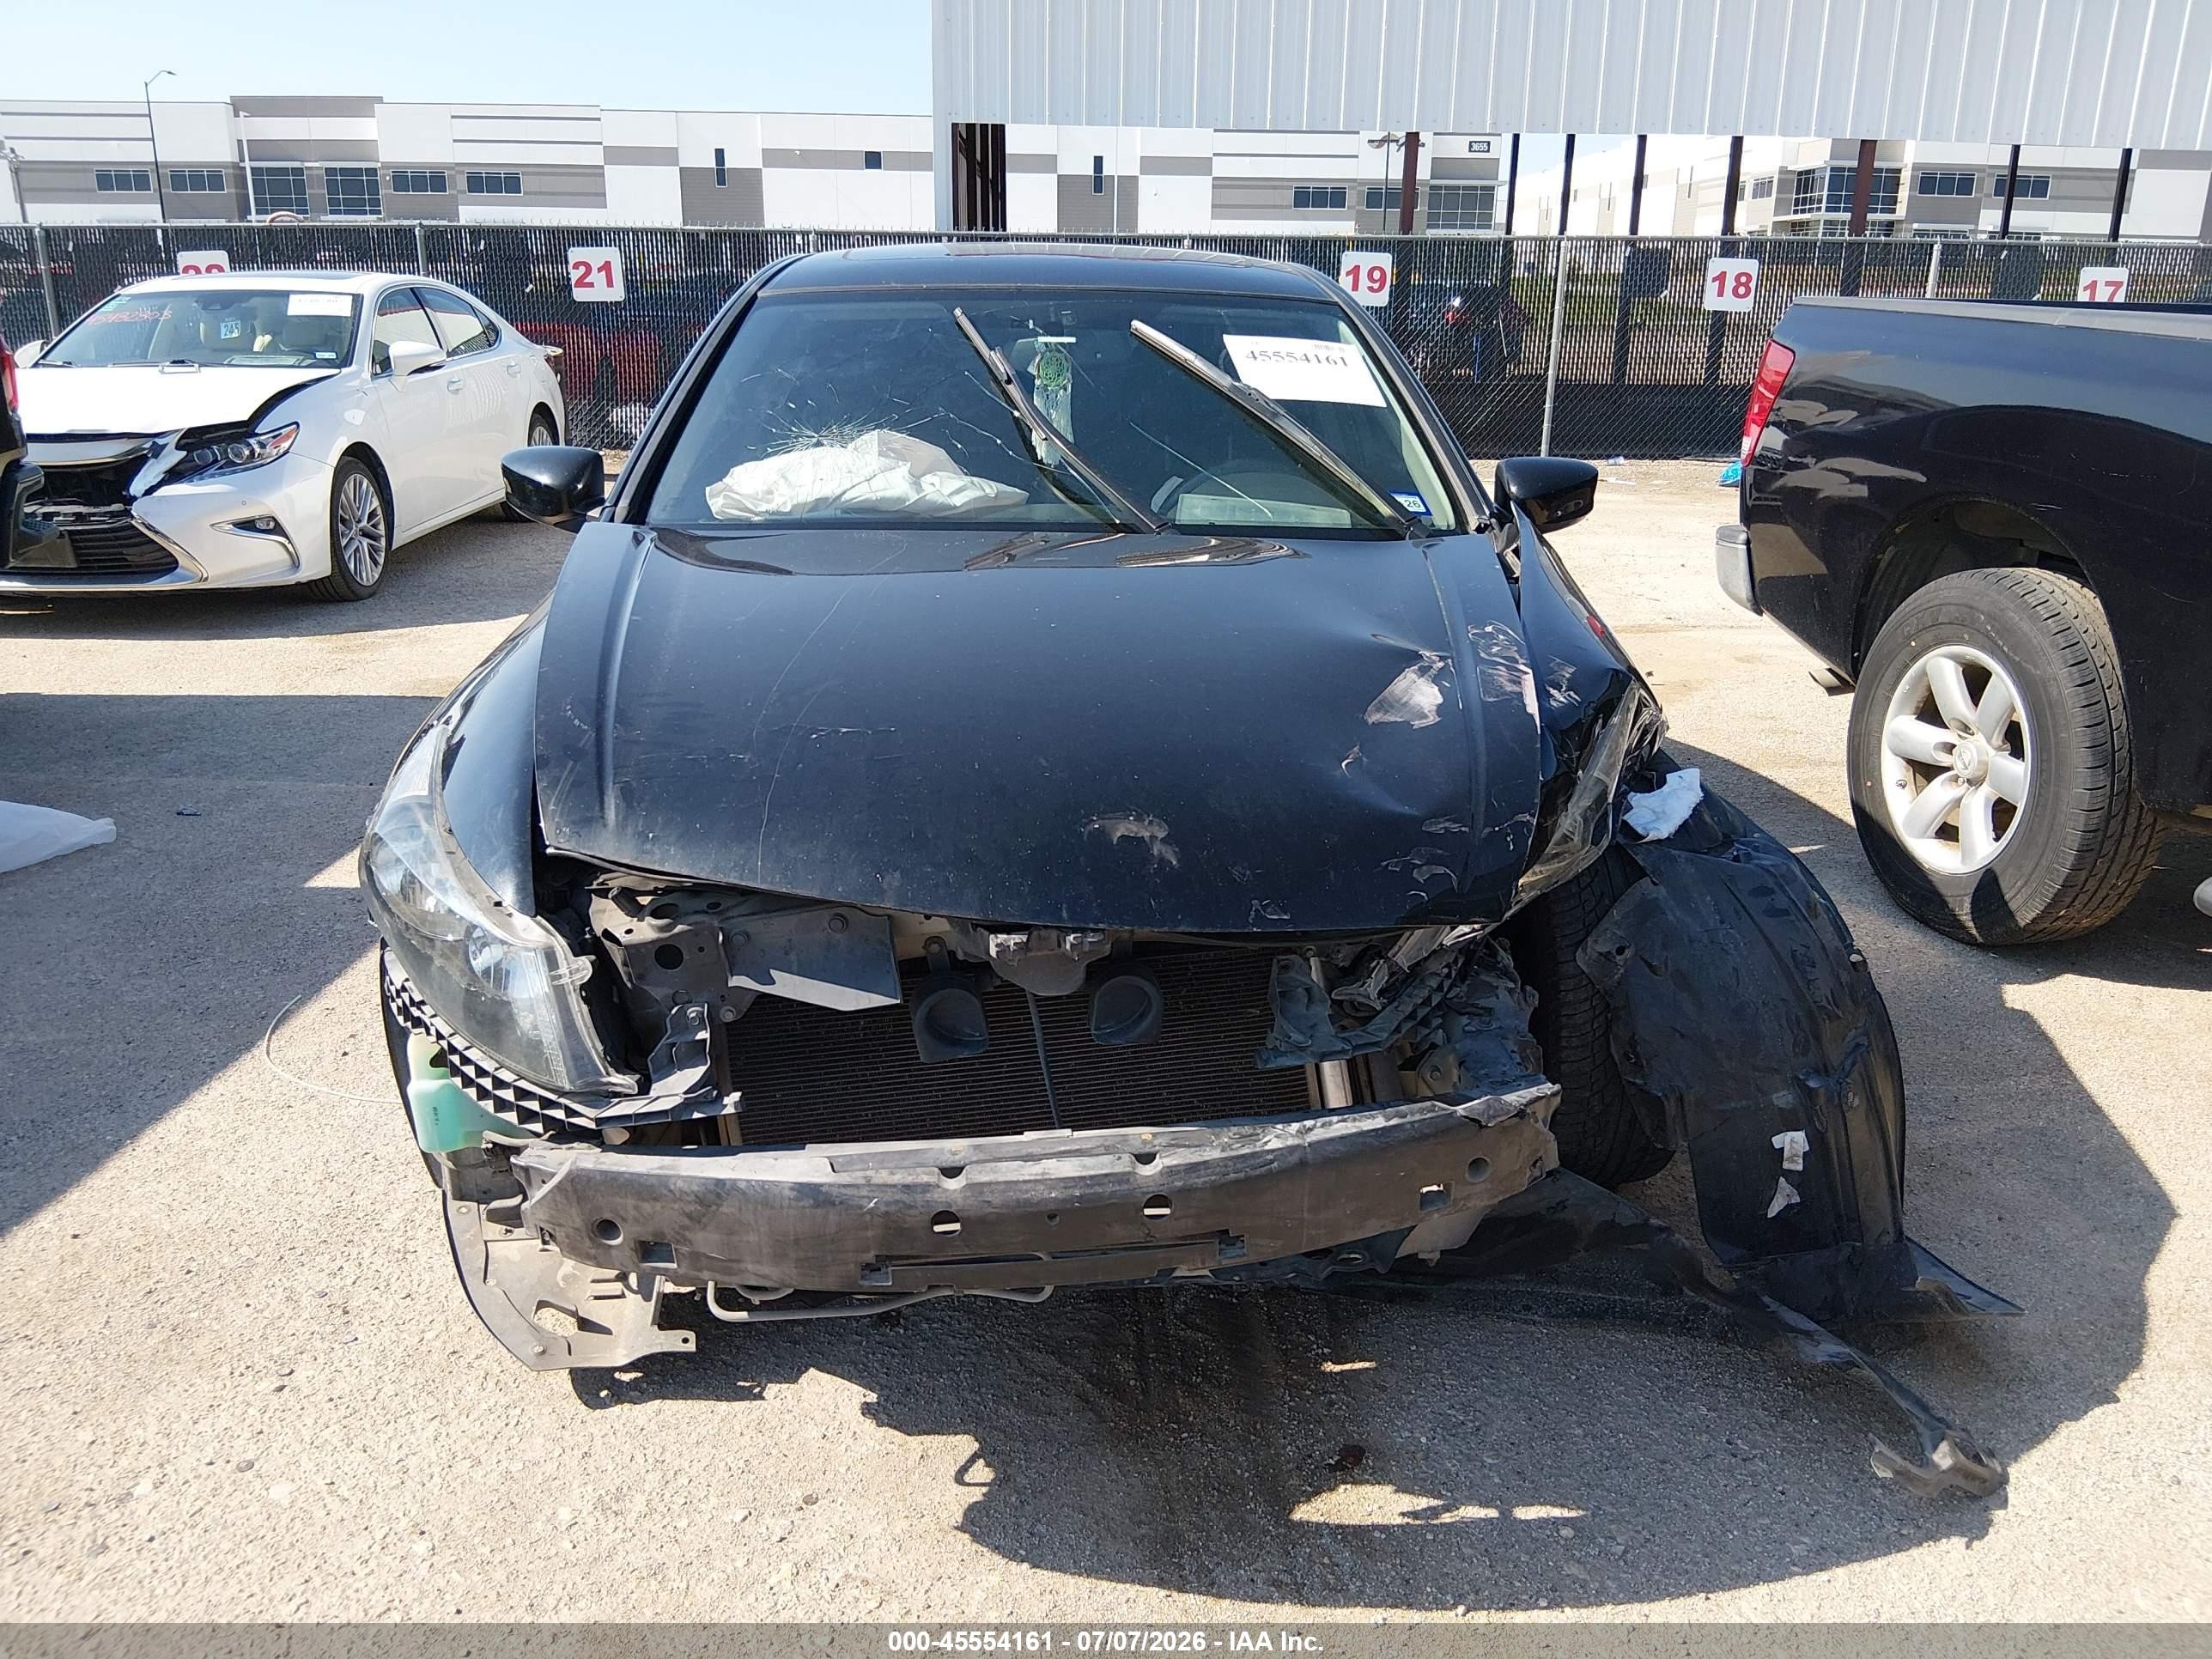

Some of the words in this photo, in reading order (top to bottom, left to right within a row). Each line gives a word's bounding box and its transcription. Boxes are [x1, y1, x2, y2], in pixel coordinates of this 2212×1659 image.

[1470, 142, 1489, 152] 3655
[571, 260, 614, 289] 21
[1345, 264, 1388, 294] 19
[1711, 270, 1753, 299] 18
[2082, 280, 2124, 302] 17
[1245, 349, 1349, 368] 45554161
[1404, 499, 1421, 508] 26
